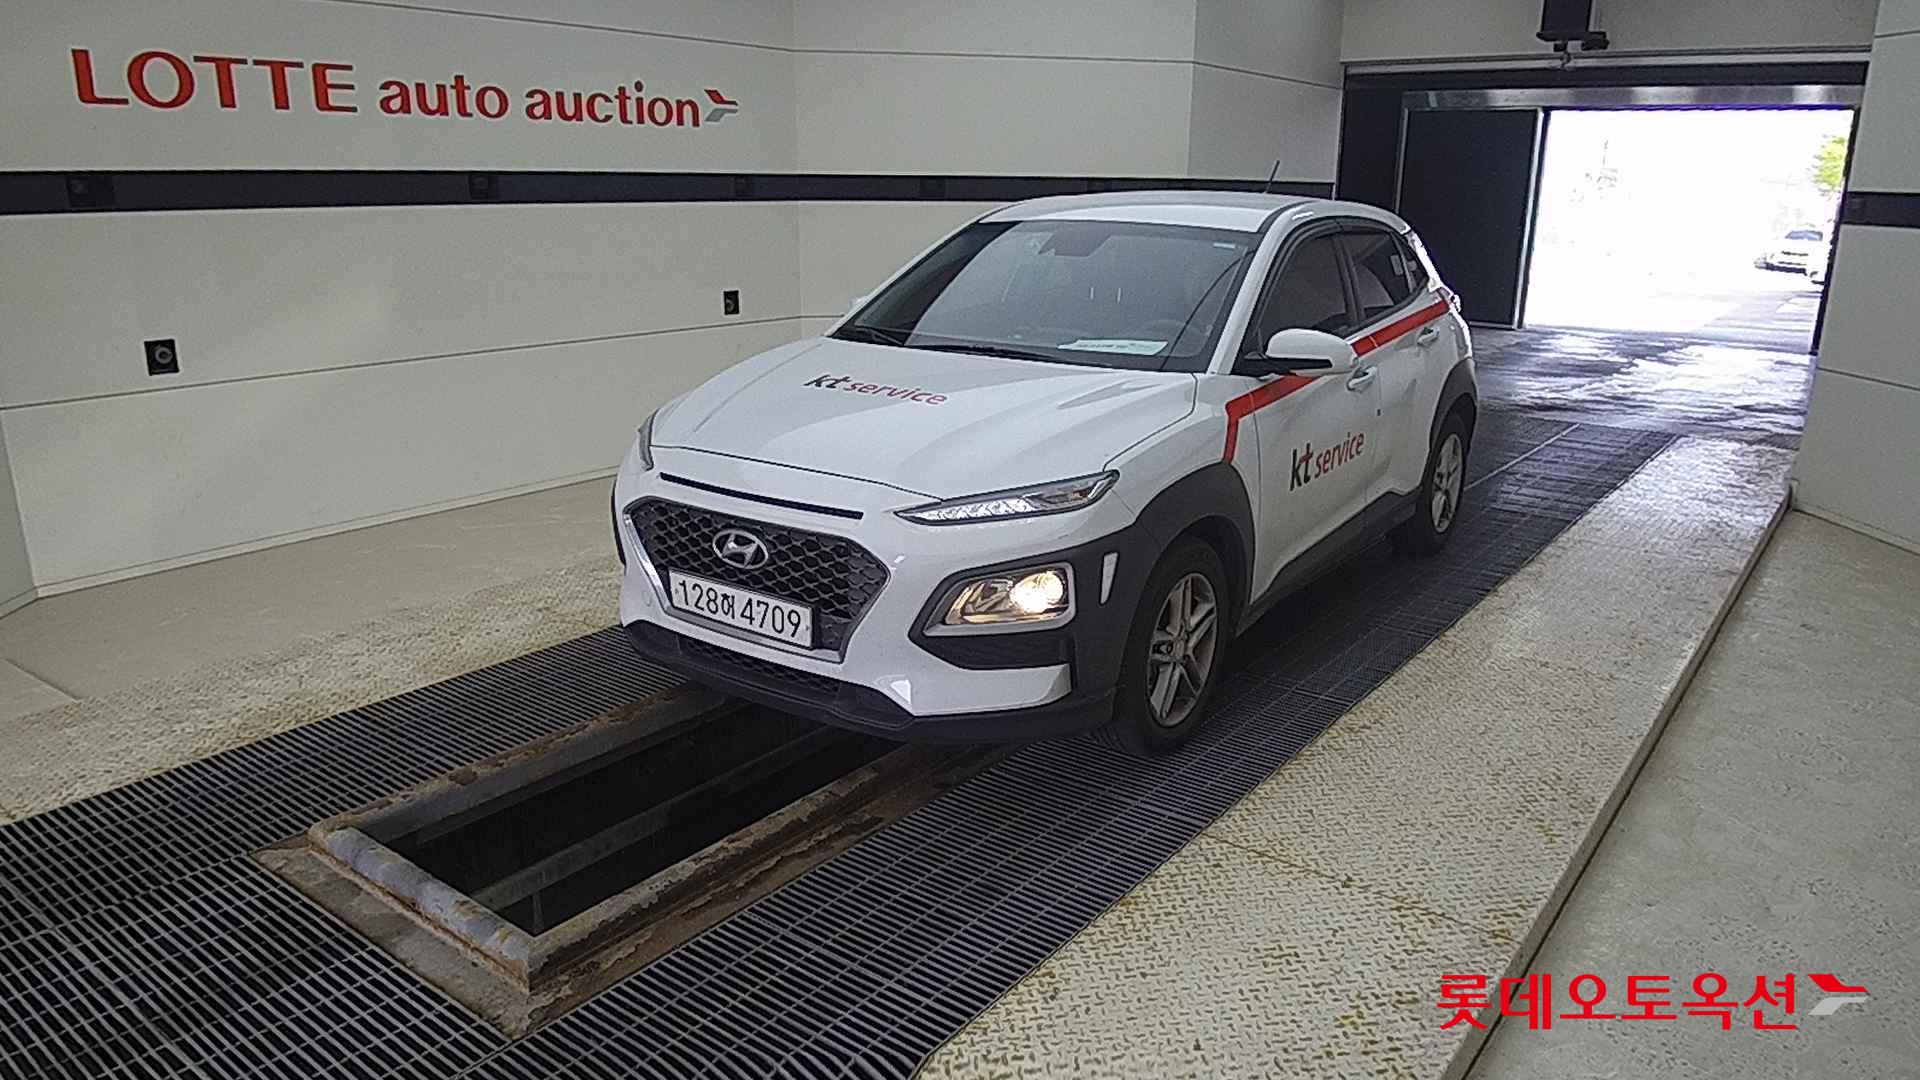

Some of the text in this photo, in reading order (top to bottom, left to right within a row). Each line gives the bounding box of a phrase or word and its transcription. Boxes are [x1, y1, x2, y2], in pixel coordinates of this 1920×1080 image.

[71, 48, 700, 127] LOTTE auto auction
[804, 374, 947, 405] kt service
[1289, 431, 1365, 491] kt service
